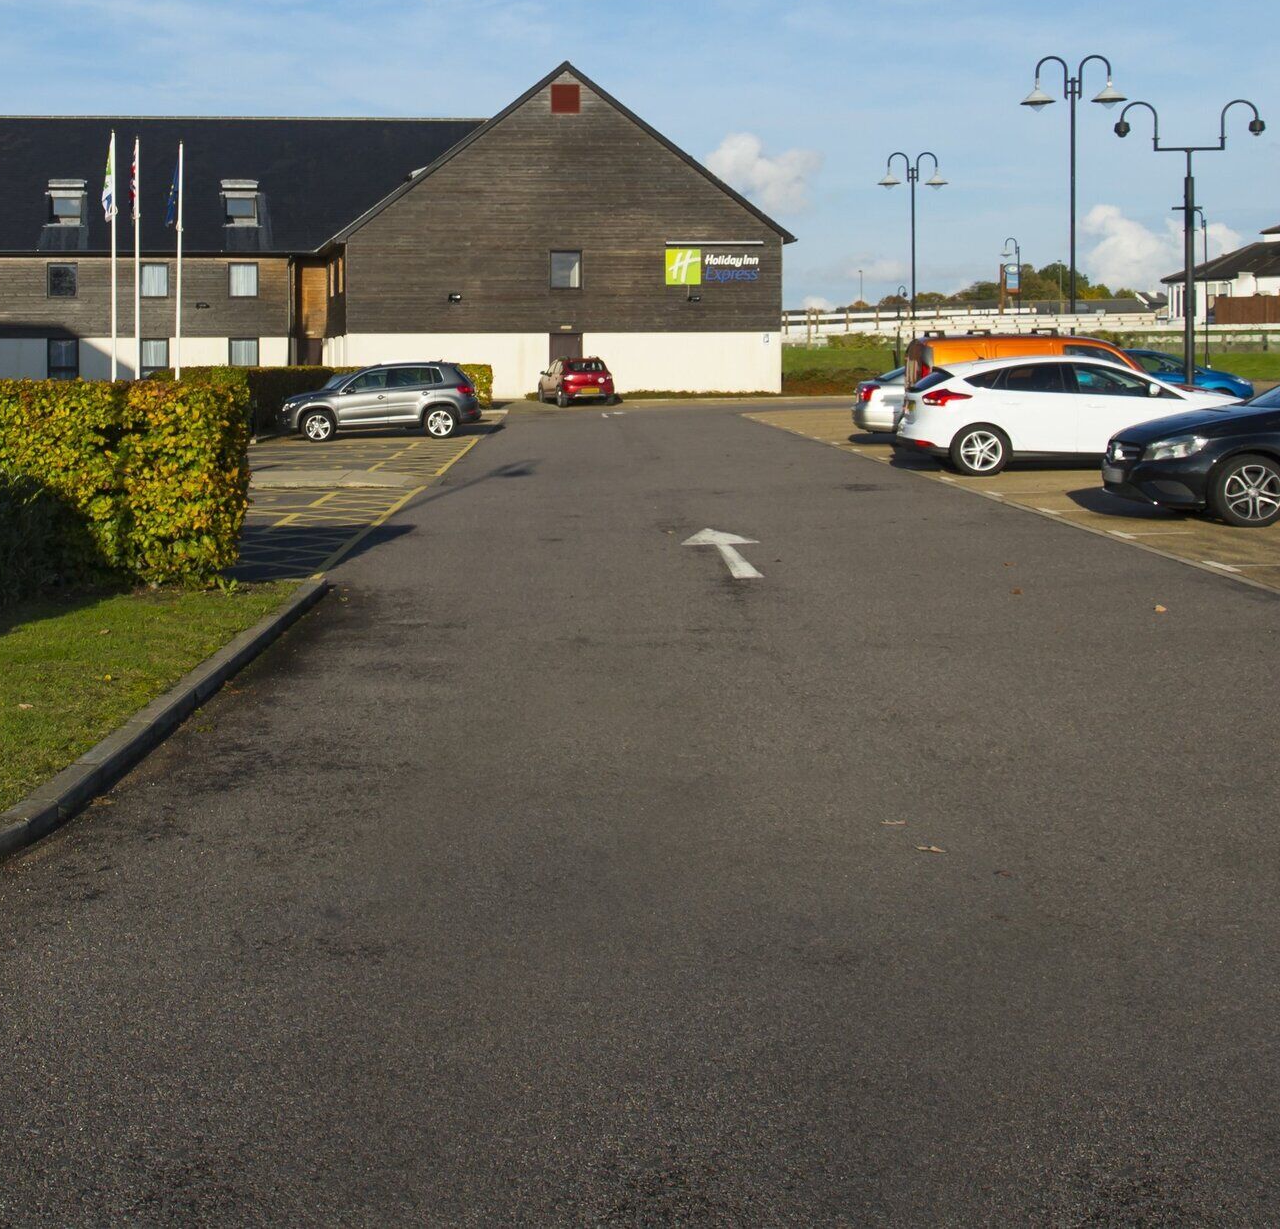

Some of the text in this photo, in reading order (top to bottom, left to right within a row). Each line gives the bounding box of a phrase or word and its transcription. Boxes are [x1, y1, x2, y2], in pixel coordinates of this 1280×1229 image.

[705, 254, 759, 267] Holiday Inn
[705, 266, 759, 282] Express
